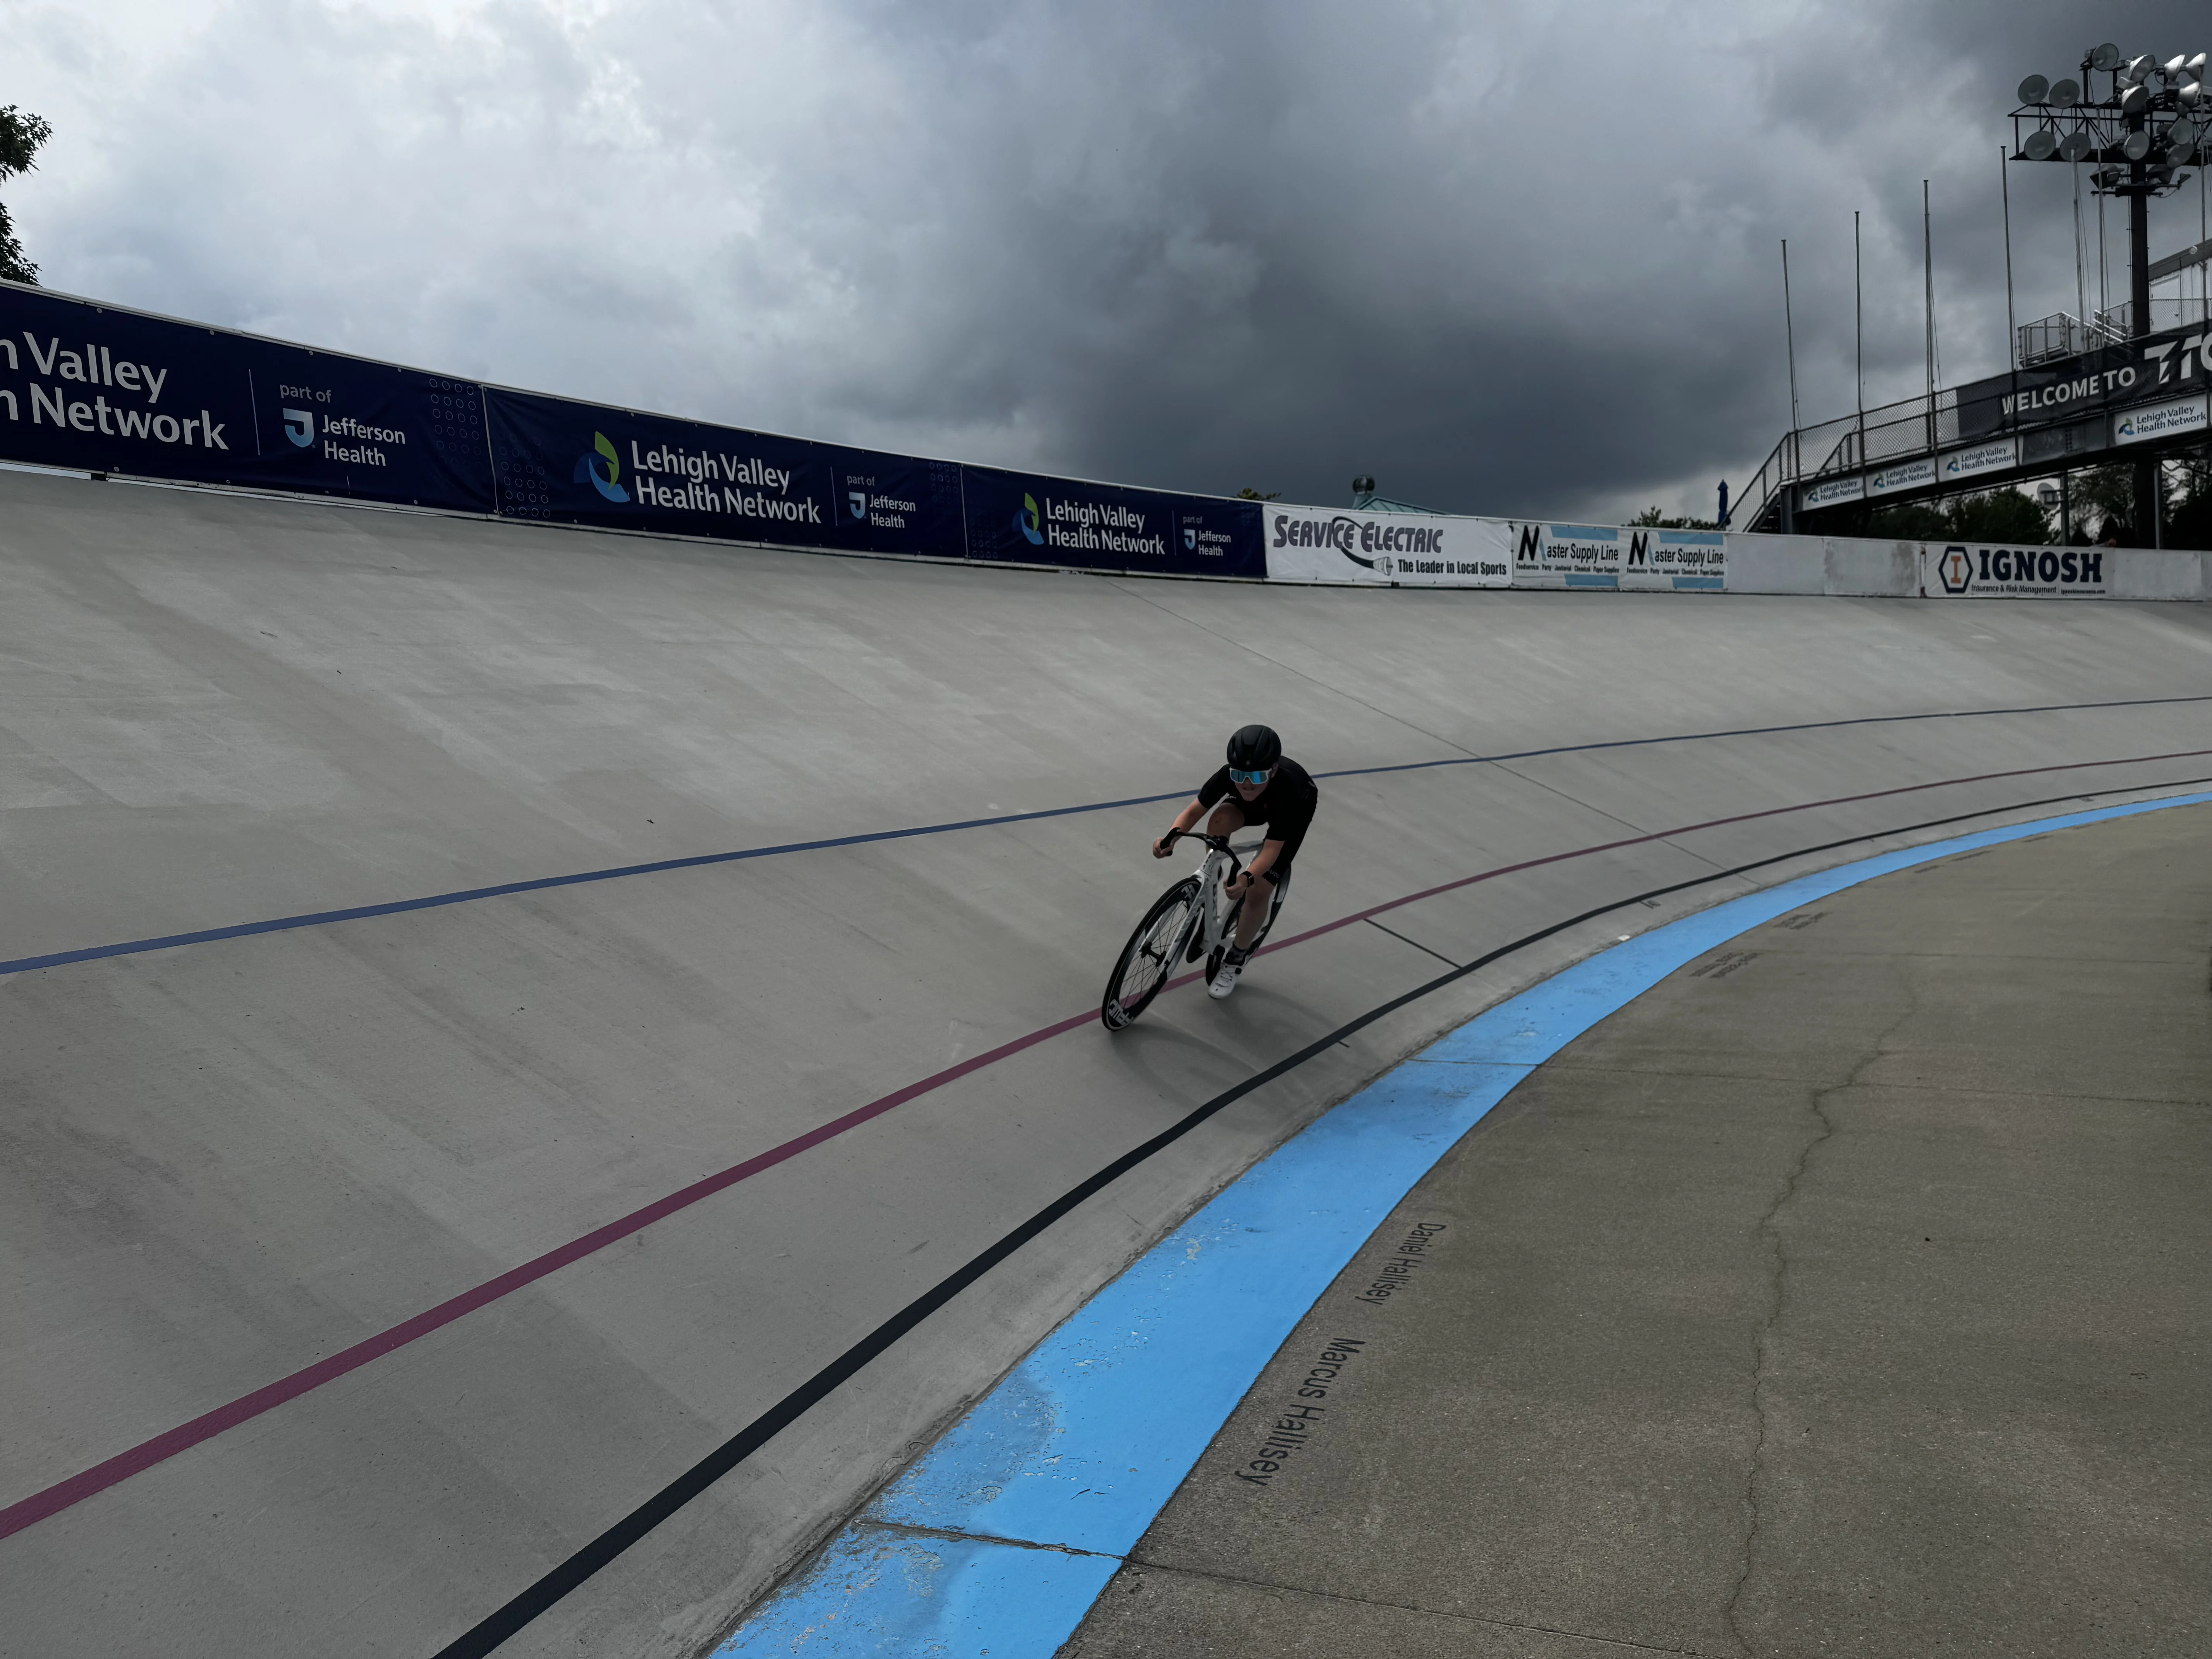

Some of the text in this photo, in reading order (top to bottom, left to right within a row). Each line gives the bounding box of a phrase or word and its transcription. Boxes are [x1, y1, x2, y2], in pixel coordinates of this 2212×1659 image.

[23, 331, 167, 404] Valley
[279, 384, 331, 403] part of
[2001, 374, 2099, 416] WELCOME
[2103, 366, 2136, 390] TO
[30, 383, 230, 450] Network
[2137, 406, 2195, 424] Lehigh Valley
[2137, 412, 2206, 434] Health Network
[322, 414, 406, 445] Jefferson
[324, 440, 386, 467] Health
[1961, 446, 2008, 462] Lehigh Valley
[631, 440, 790, 495] Lehigh Valley
[1961, 459, 1984, 471] Health
[847, 474, 875, 486] part of
[635, 476, 821, 524] Health Network
[869, 494, 916, 512] Jefferson
[871, 512, 905, 529] Health
[1046, 498, 1145, 534] Lehigh Valley
[1183, 515, 1203, 524] part of
[1048, 524, 1165, 555] Health Network
[1198, 530, 1231, 543] Jefferson
[1273, 515, 1443, 553] SERVICE ELECTRIC
[1198, 544, 1223, 556] Health
[1570, 545, 1599, 564] Supply
[1601, 544, 1619, 561] Line
[1677, 549, 1705, 567] Supply
[1707, 548, 1724, 565] Line
[1397, 559, 1507, 576] The Leader in Local Sports
[1979, 549, 2103, 583] IGNOSH
[1971, 584, 1999, 592] Insurance
[2000, 584, 2004, 593] &
[2006, 584, 2018, 593] Risk
[2019, 585, 2057, 594] Management
[1355, 1223, 1446, 1305] Daniel Hallisey
[1234, 1338, 1366, 1486] Marcus Hallisey
